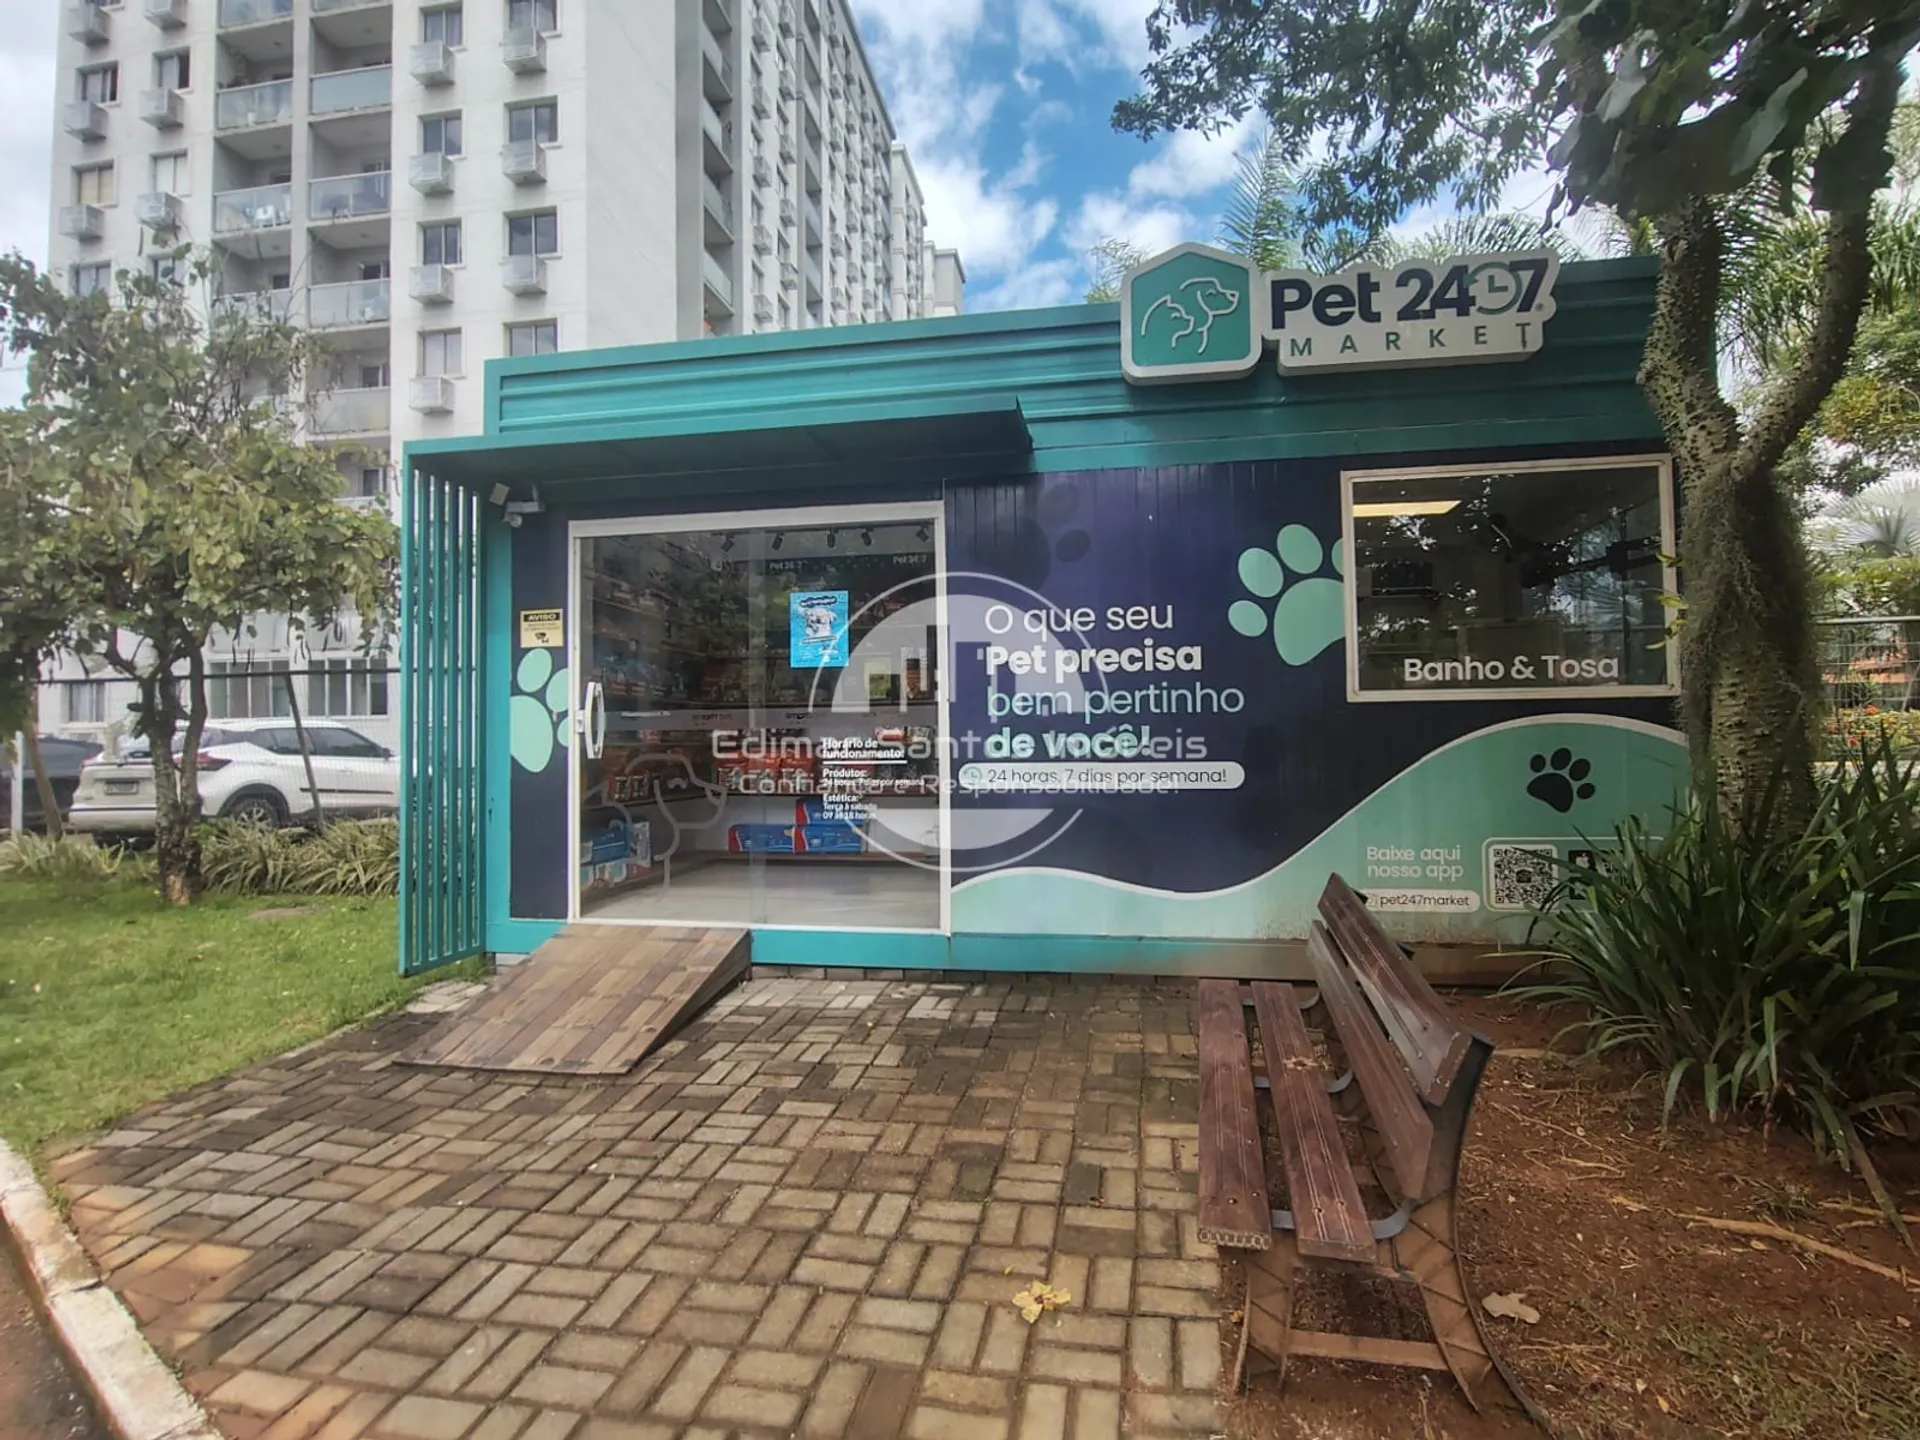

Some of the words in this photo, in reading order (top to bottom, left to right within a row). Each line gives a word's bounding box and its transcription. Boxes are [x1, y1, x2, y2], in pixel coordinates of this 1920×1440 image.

[1271, 271, 1382, 330] Pet
[1290, 322, 1531, 357] MARKET
[984, 605, 1013, 634] O
[1024, 606, 1096, 642] que
[1106, 604, 1173, 631] seu
[986, 645, 1046, 676] Pet
[1055, 638, 1202, 684] precisa
[1404, 656, 1504, 682] Banho
[1510, 655, 1537, 680] &
[1541, 654, 1619, 680] Tosa
[987, 685, 1073, 717] bem
[1084, 681, 1245, 724] pertinho
[823, 737, 863, 749] Horário
[865, 737, 879, 748] de
[985, 727, 1036, 759] de
[1042, 723, 1152, 759] você!
[987, 769, 1008, 783] 24
[1065, 769, 1074, 782] 7
[1078, 768, 1113, 783] dias
[1117, 771, 1145, 788] por
[1151, 768, 1227, 783] semana!
[1366, 845, 1415, 861] Baixe
[1420, 845, 1461, 865] aqui
[1367, 864, 1421, 877] nosso
[1426, 864, 1464, 882] app
[1380, 894, 1470, 907] pet247market
